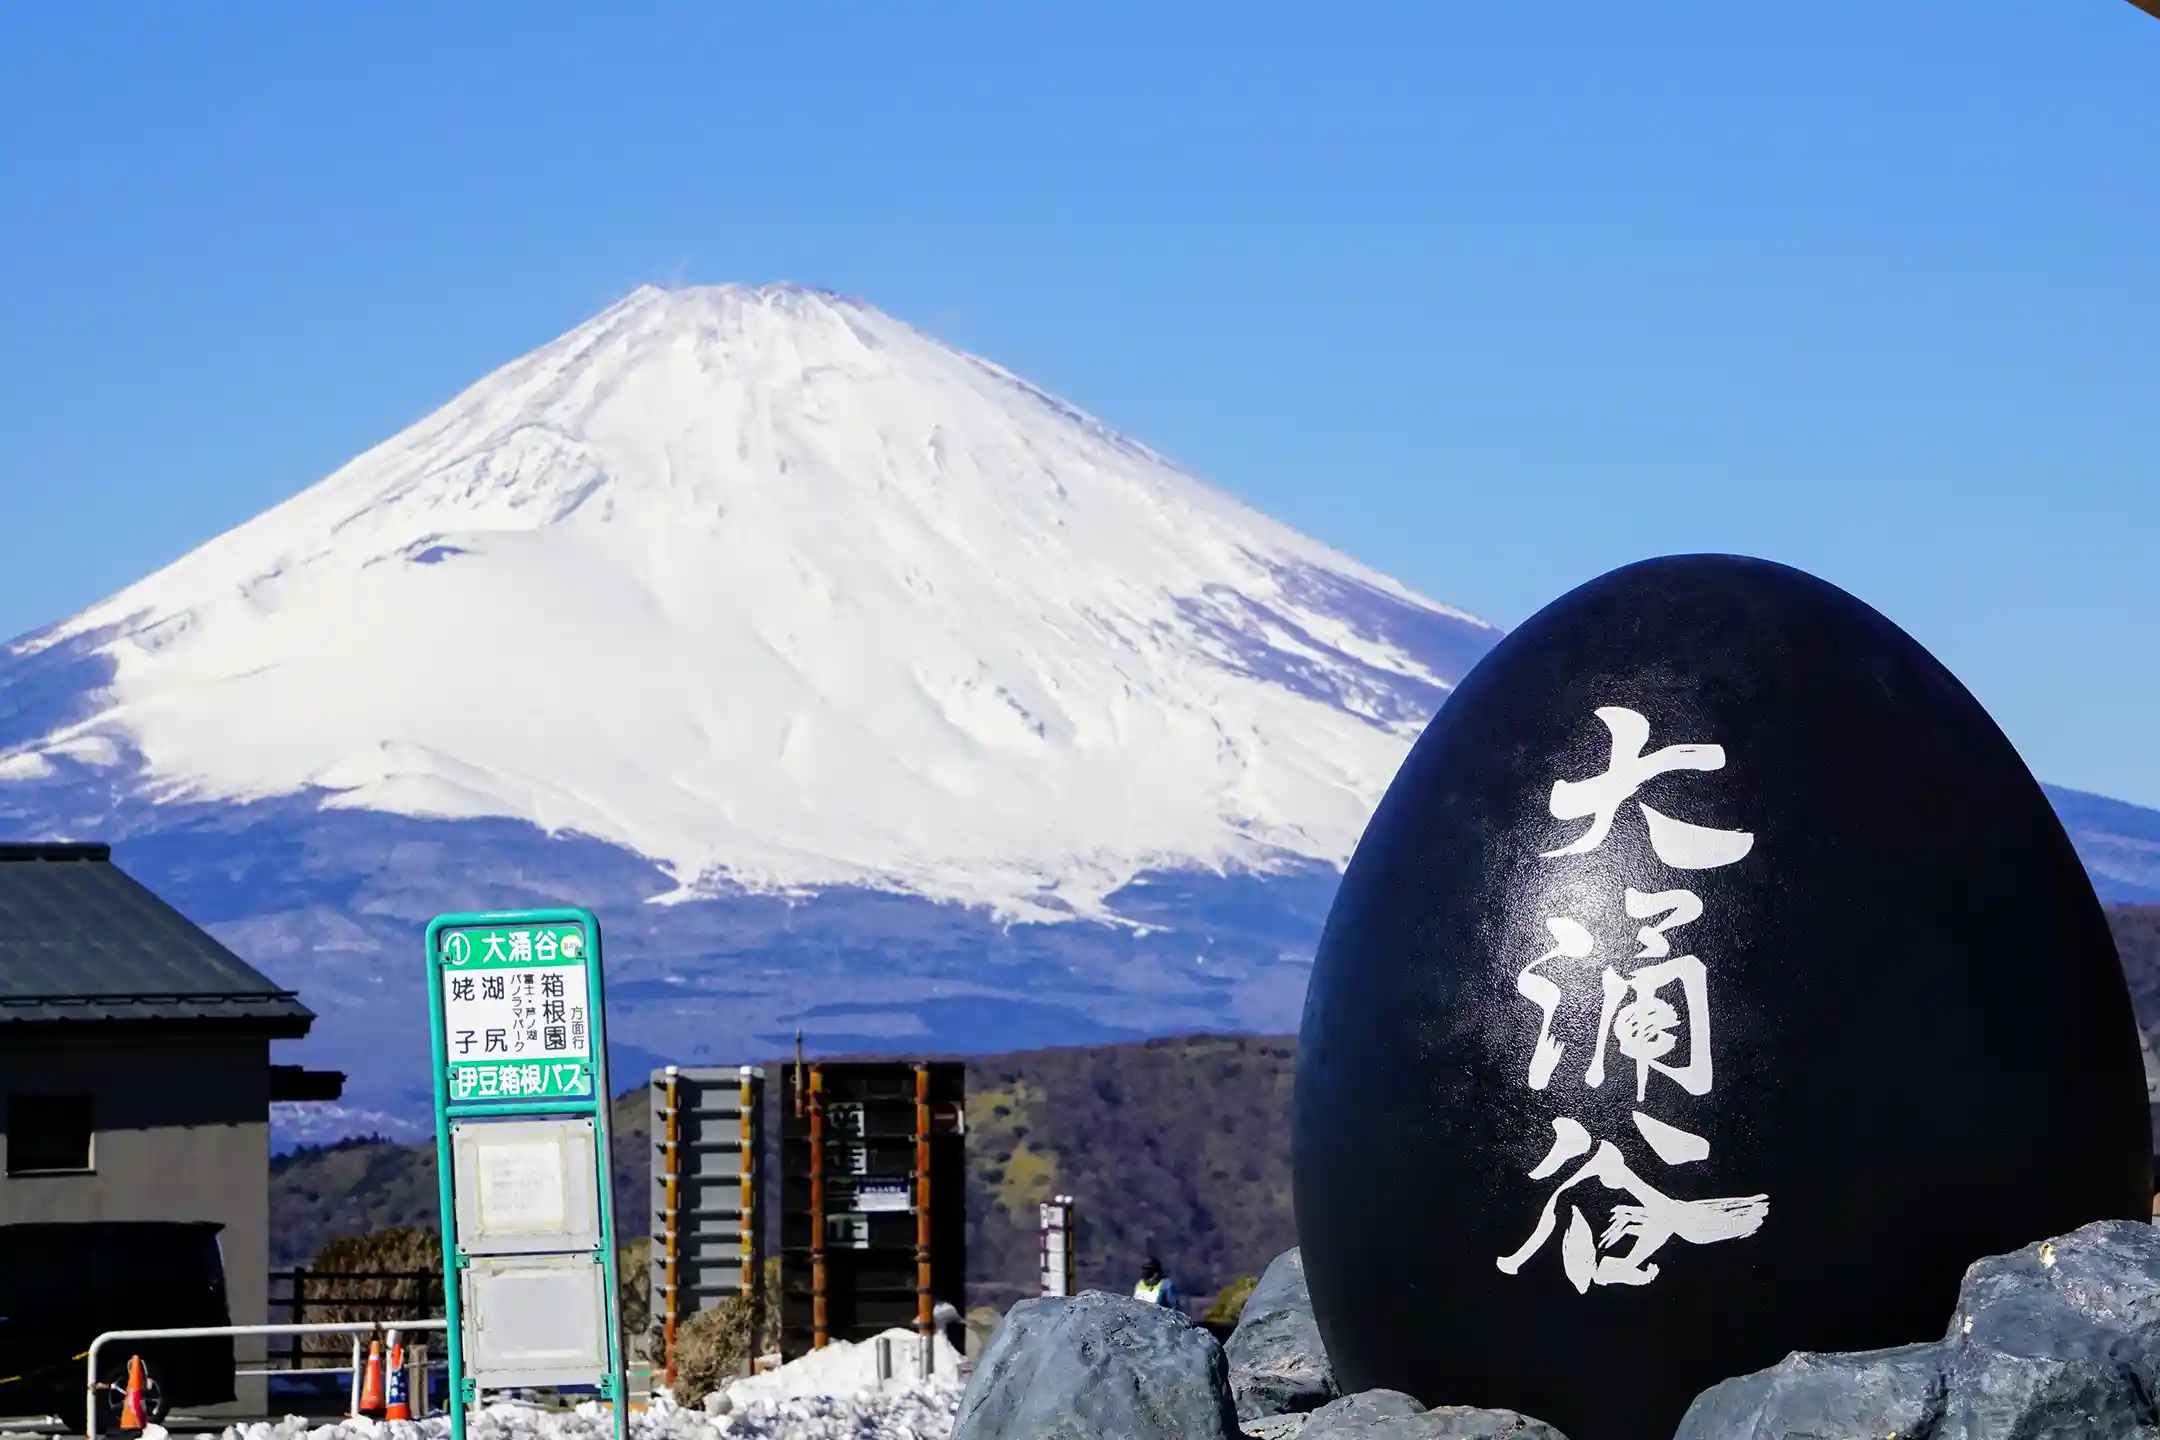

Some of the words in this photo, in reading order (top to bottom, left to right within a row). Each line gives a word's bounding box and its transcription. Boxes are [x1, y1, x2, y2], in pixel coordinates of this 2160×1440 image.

[482, 930, 559, 964] 大涌谷
[540, 972, 567, 1051] 箱根園
[1497, 706, 1770, 1295] 大涌谷
[570, 1005, 585, 1051] 方面行
[456, 1062, 585, 1097] 伊豆箱根バス
